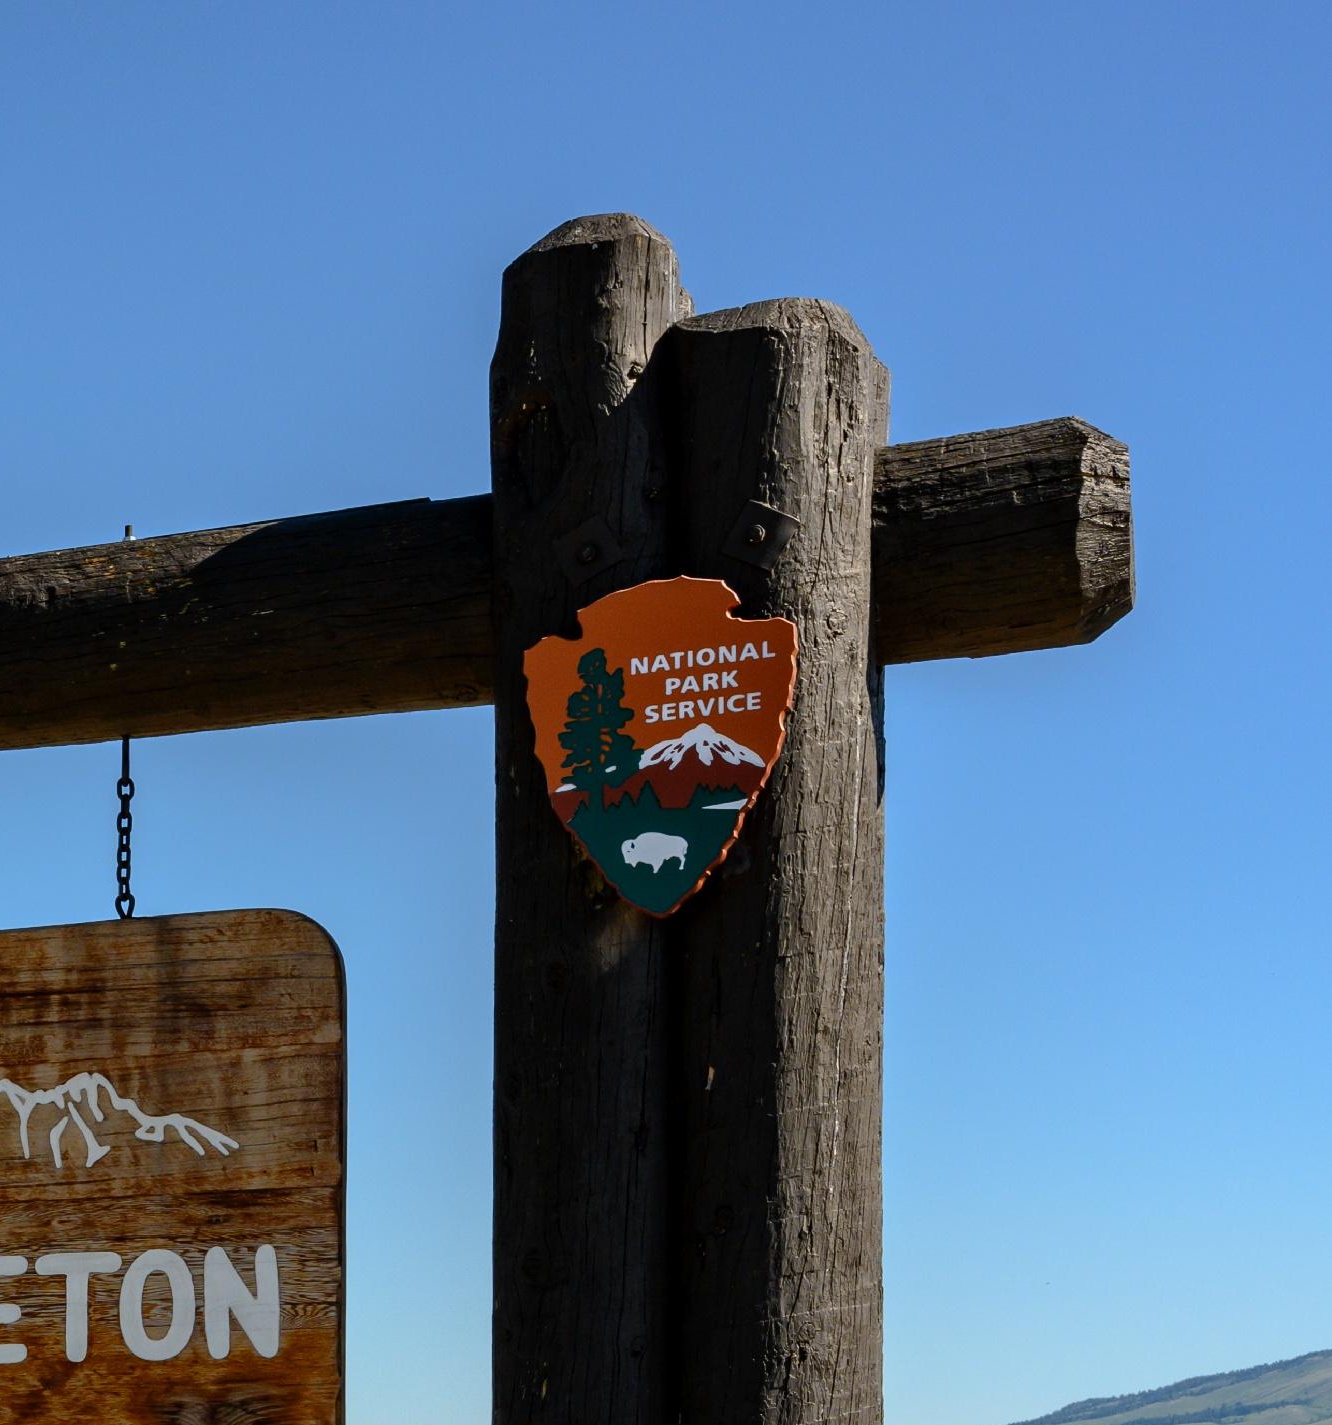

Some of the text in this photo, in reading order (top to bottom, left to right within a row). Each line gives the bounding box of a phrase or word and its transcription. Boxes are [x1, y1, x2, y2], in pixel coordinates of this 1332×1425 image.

[630, 640, 776, 675] NATIONAL
[665, 670, 738, 695] PARK
[644, 691, 762, 724] SERVICE
